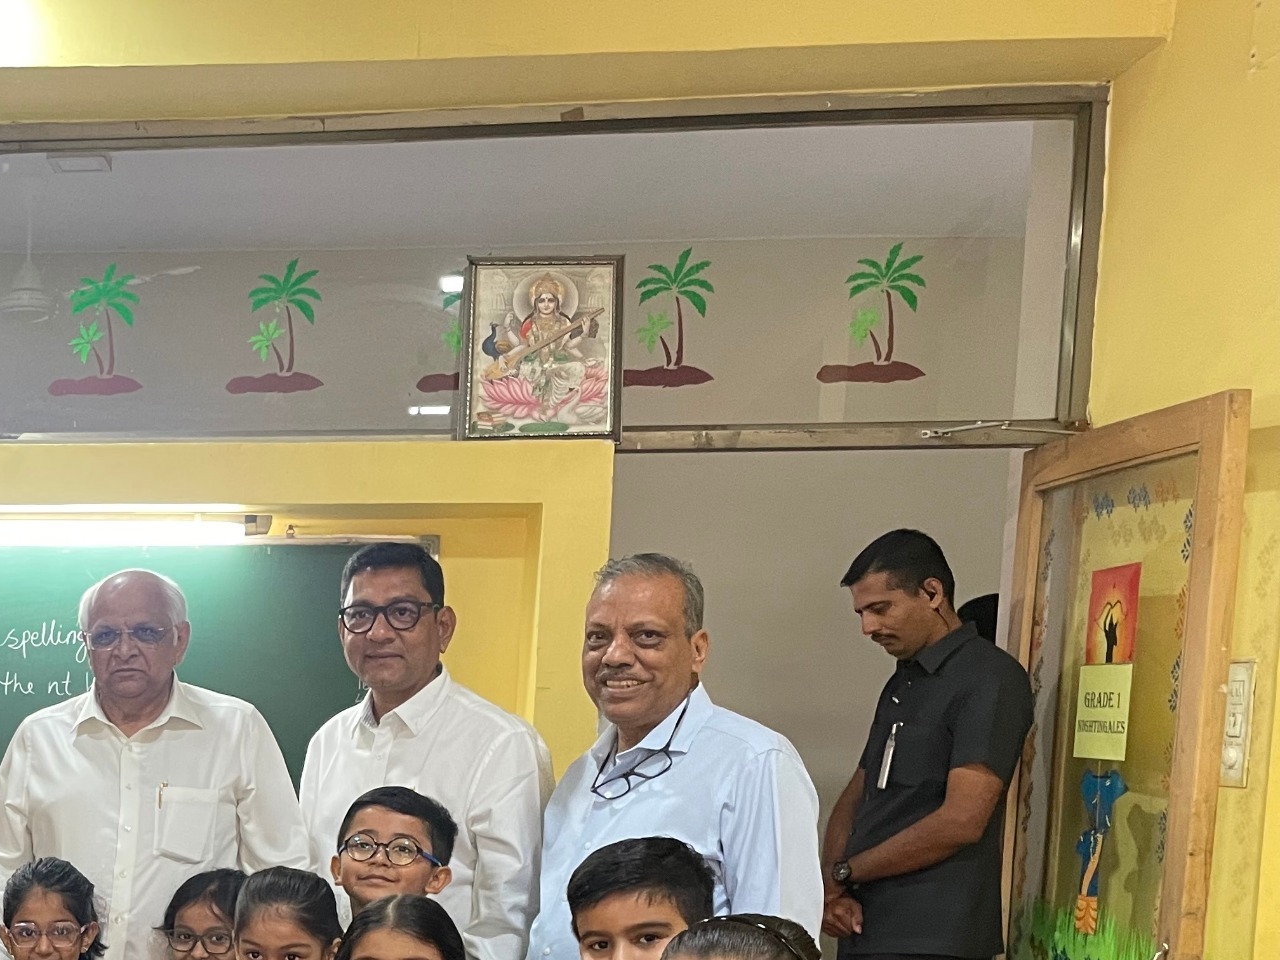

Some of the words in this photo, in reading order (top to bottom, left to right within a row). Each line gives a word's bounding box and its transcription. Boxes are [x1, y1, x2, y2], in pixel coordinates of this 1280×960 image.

[1083, 690, 1115, 710] GRADE
[1116, 691, 1122, 709] 1
[1076, 720, 1126, 735] NIGHTINGALES
